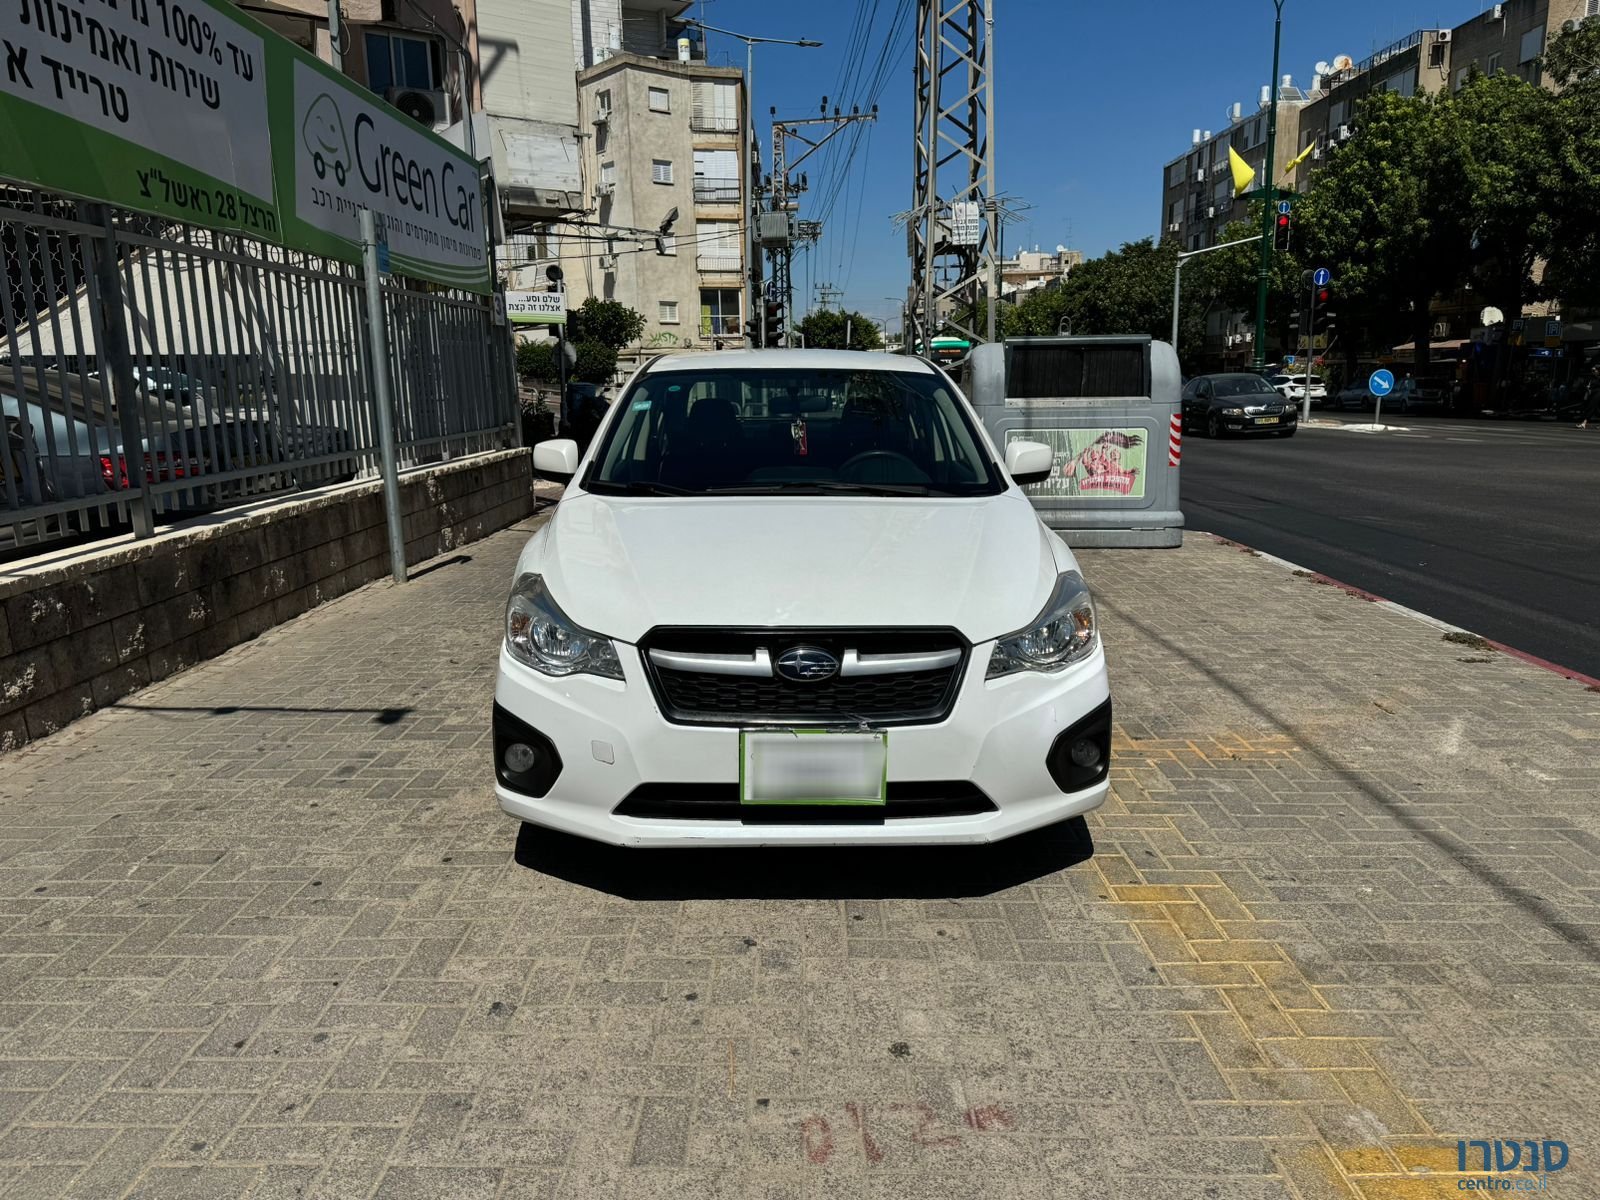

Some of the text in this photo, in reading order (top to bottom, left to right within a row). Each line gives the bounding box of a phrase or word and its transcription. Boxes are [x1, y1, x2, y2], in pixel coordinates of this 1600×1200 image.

[156, 0, 223, 66] 100%
[226, 41, 254, 82] עד
[41, 55, 129, 123] טרייד
[148, 47, 221, 110] שירות
[354, 112, 475, 233] Green Car
[215, 190, 237, 222] 28
[311, 187, 333, 209] רכב
[239, 197, 277, 233] הרצל
[405, 221, 439, 246] מתקדמים
[440, 235, 458, 252] מימון
[508, 303, 526, 312] קצת
[540, 303, 561, 312] אצלנו
[542, 294, 561, 303] שלם
